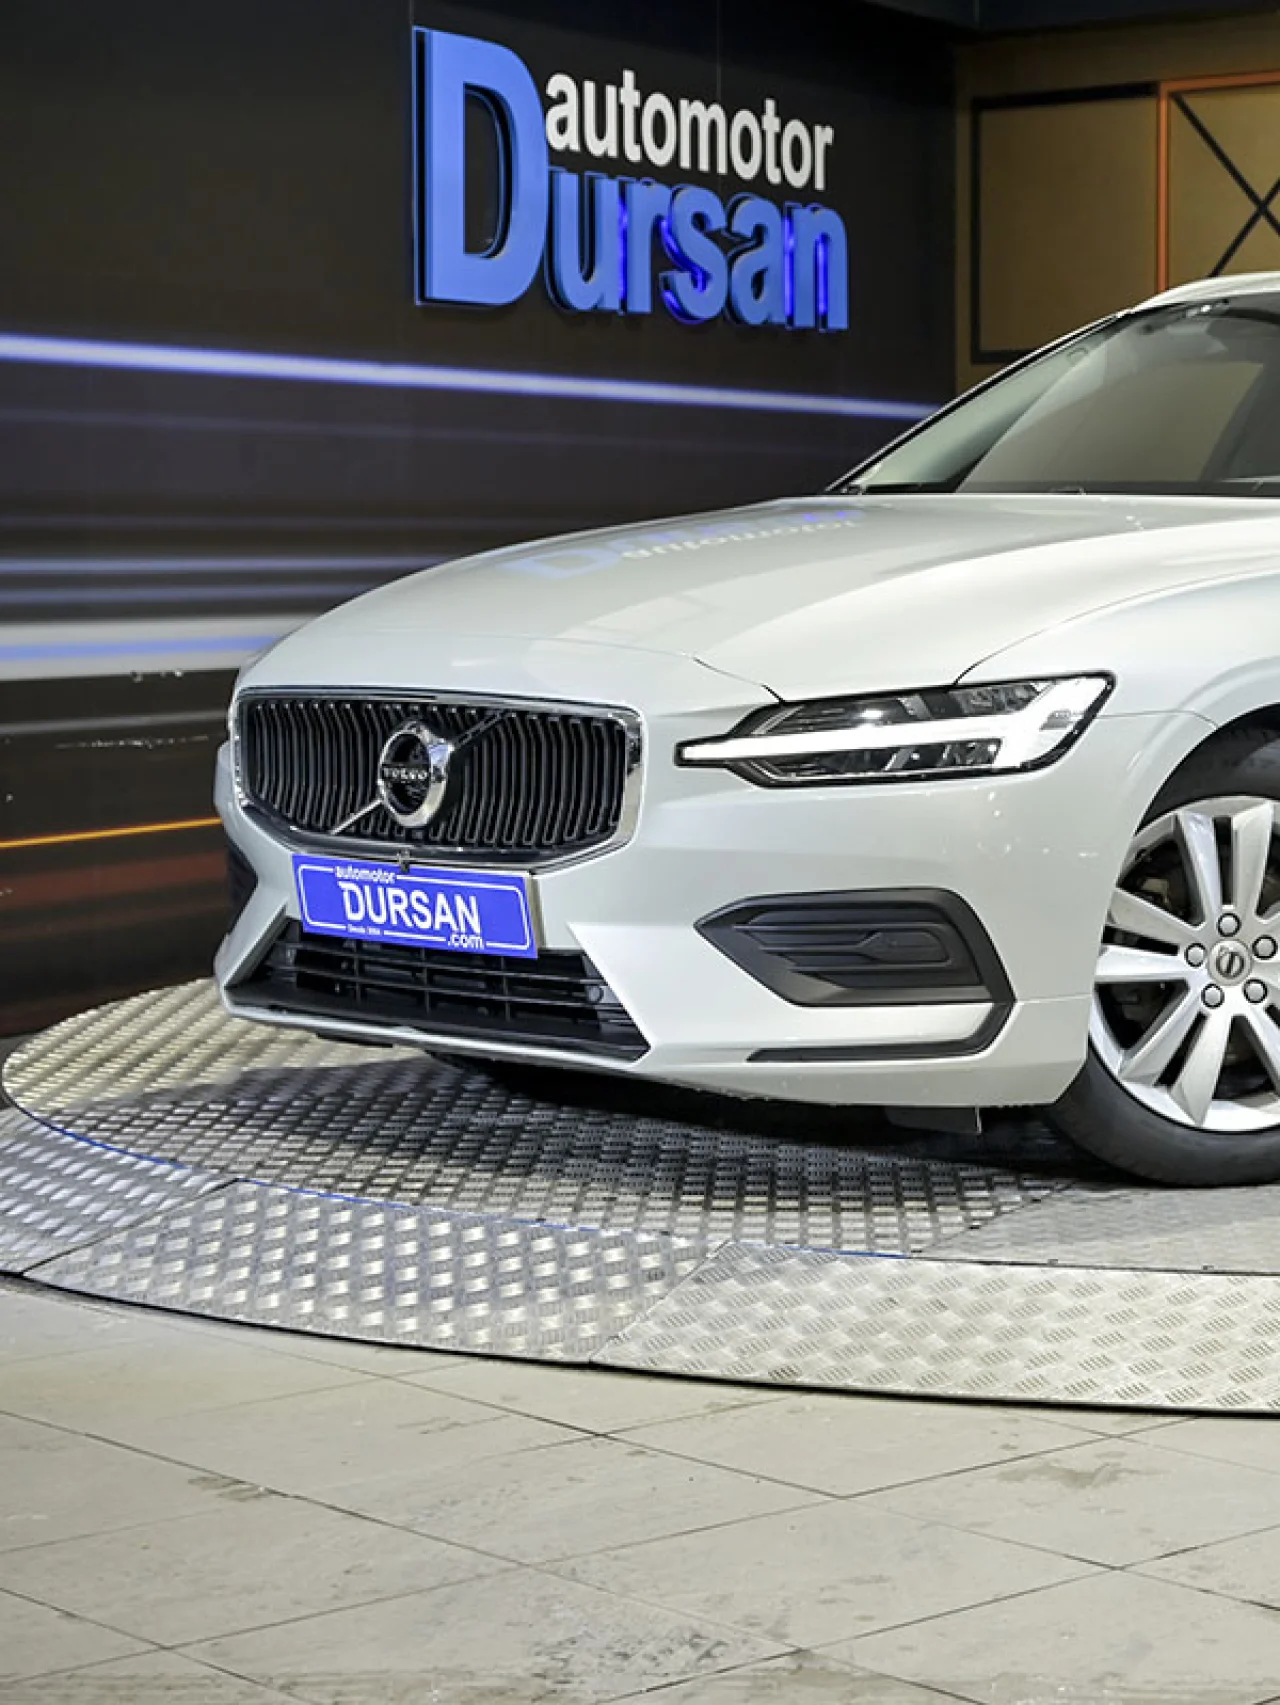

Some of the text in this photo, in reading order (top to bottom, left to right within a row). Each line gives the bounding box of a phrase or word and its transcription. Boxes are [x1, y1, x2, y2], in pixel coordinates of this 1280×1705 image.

[546, 70, 834, 190] automotor
[412, 26, 849, 332] Dursan
[335, 865, 396, 884] automotor
[338, 881, 482, 935] DURSAN
[447, 933, 484, 950] .com
